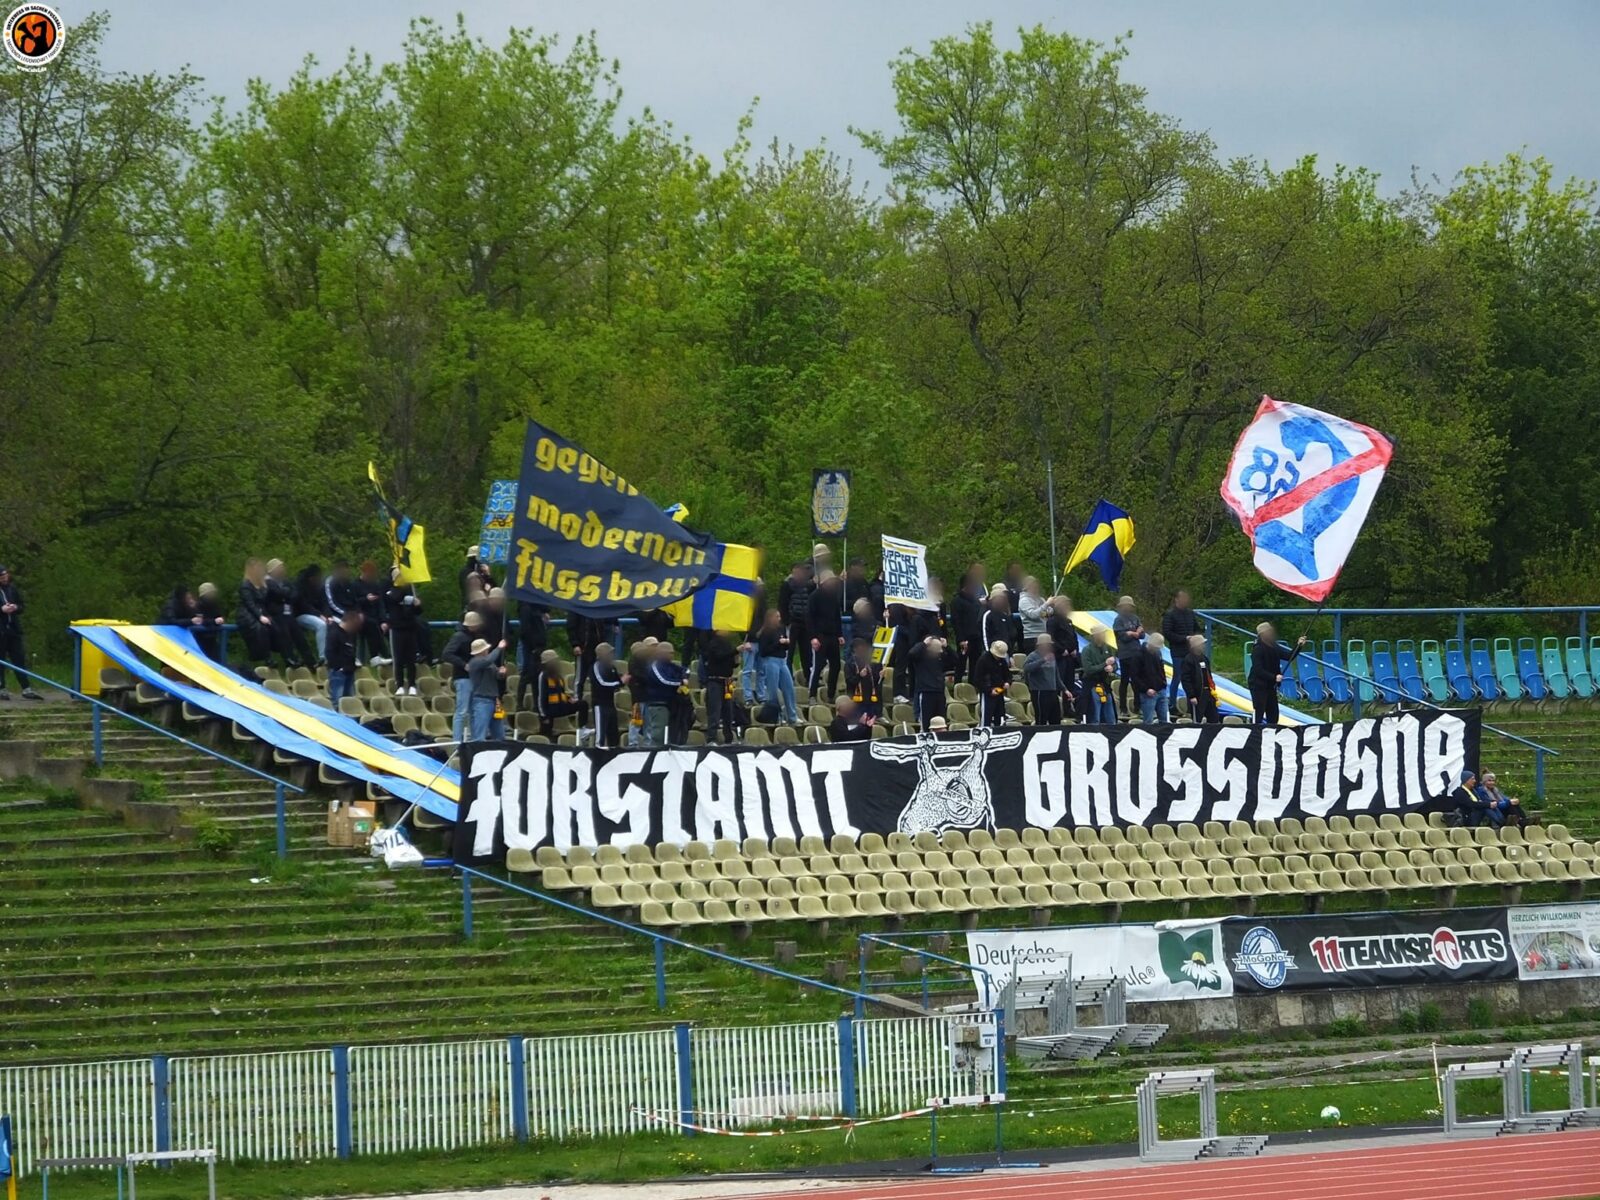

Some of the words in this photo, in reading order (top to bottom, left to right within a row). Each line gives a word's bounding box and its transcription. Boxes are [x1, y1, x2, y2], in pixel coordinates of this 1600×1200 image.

[526, 495, 706, 567] modernen
[464, 748, 862, 857] FORSTAMT
[1511, 913, 1539, 923] HERZLICH
[1540, 911, 1582, 922] WILLKOMMEN
[976, 940, 1056, 966] Deutsche
[1243, 953, 1284, 963] MoGoNo
